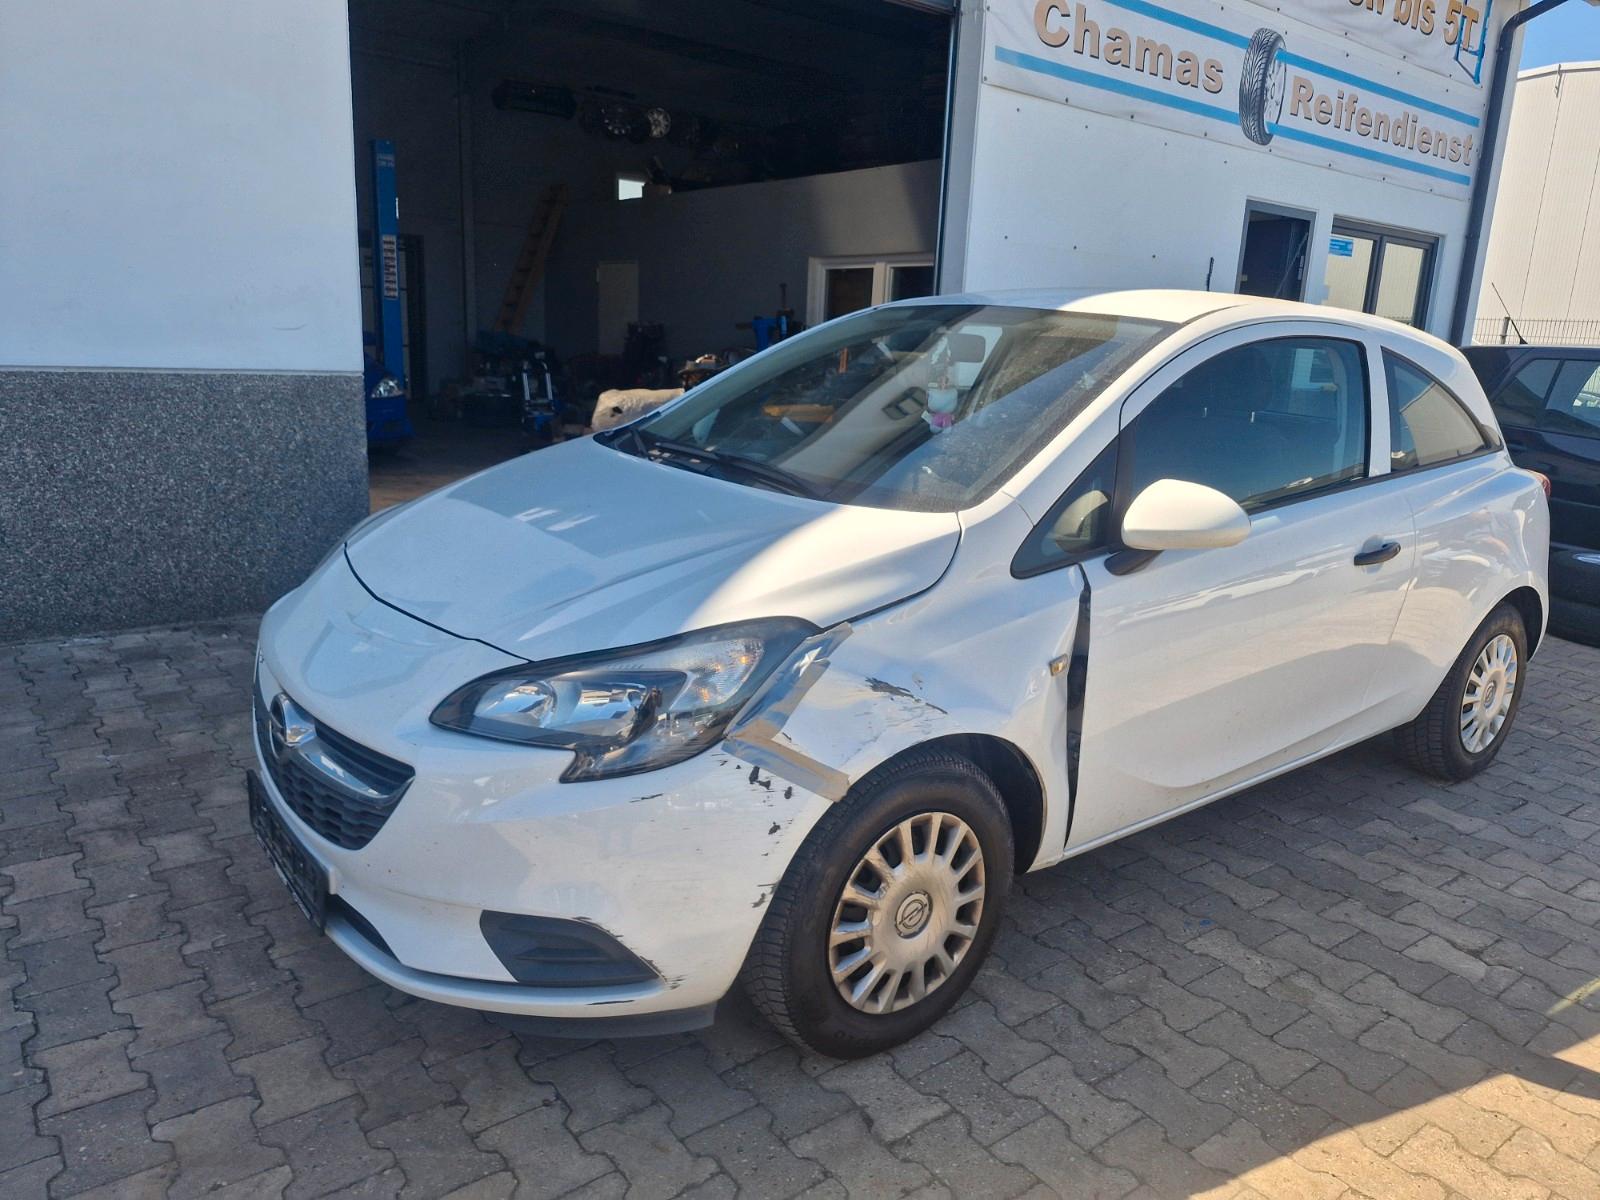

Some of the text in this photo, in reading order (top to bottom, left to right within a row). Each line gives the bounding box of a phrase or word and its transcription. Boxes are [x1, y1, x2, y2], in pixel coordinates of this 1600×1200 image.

[1444, 0, 1480, 52] 5T
[1033, 0, 1474, 166] Chamas Reifendienst
